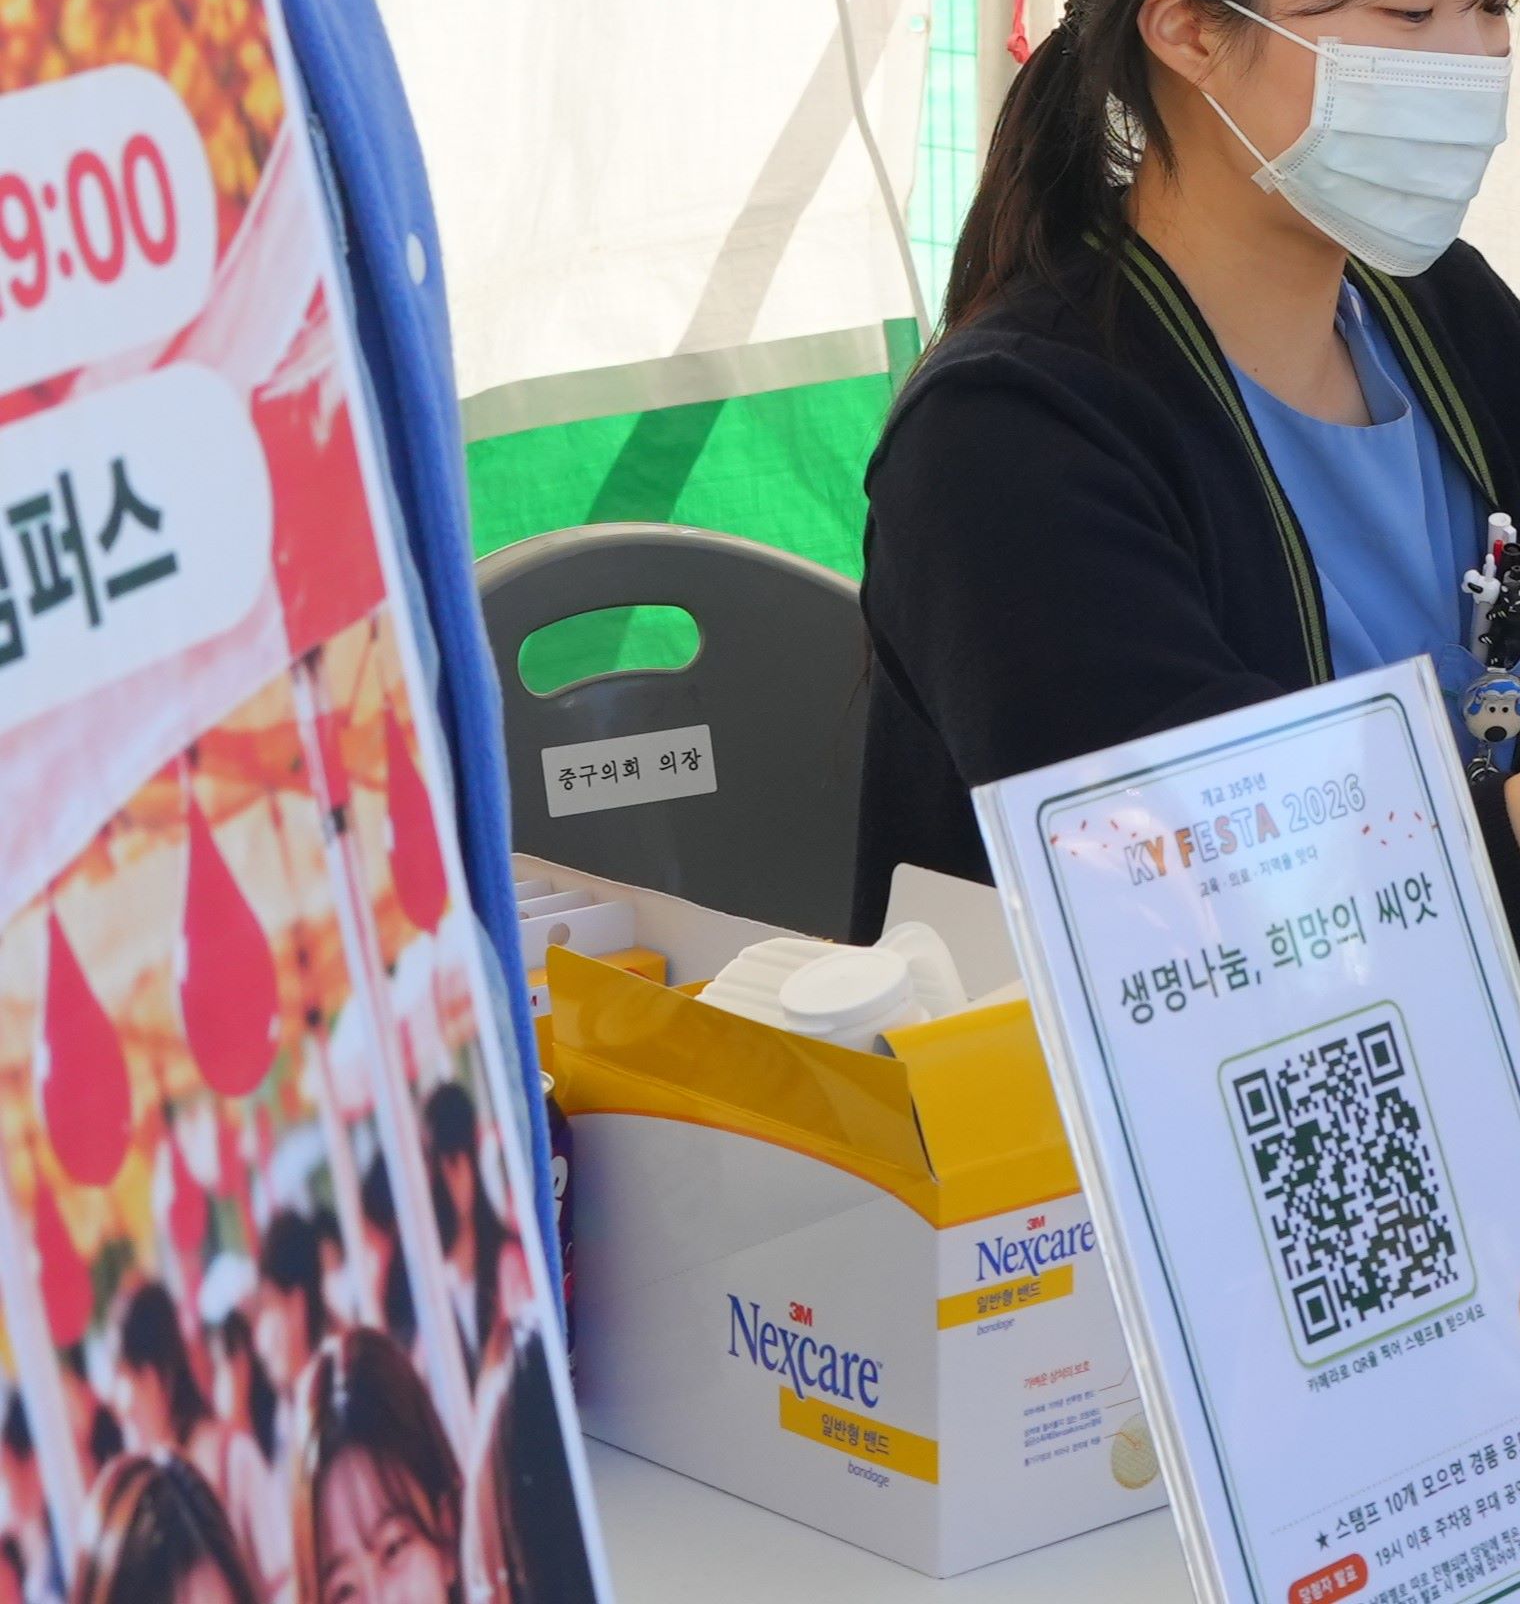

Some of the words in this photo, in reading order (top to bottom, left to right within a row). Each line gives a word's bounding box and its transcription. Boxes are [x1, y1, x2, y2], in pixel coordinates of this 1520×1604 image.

[0, 132, 178, 320] 9:00
[558, 756, 641, 791] 중구의회
[658, 747, 702, 775] 의장
[1230, 772, 1266, 799] 35주년
[1124, 836, 1166, 886] KY
[1175, 802, 1281, 869] FESTA
[1282, 773, 1366, 833] 2026
[1120, 943, 1262, 1025] 생명나눔,
[1266, 896, 1367, 968] 희망의
[1376, 872, 1438, 930] 씨앗
[976, 1220, 1096, 1281] Nexcare
[1027, 1215, 1045, 1231] 3M
[789, 1301, 813, 1327] 3M
[977, 1288, 1013, 1314] 일반형
[727, 1293, 879, 1408] Nexcare
[1307, 1363, 1350, 1393] 카메라로
[1352, 1350, 1378, 1374] QR을
[1380, 1340, 1403, 1360] 찍어
[1405, 1321, 1443, 1351] 스탬프를
[1446, 1303, 1486, 1333] 받으세요
[821, 1414, 860, 1447] 일반형
[863, 1429, 890, 1456] 밴드
[1336, 1501, 1381, 1539] 스탬프
[1385, 1482, 1419, 1515] 10개
[1422, 1459, 1466, 1498] 모으면
[1469, 1444, 1498, 1476] 경품
[1375, 1539, 1404, 1567] 19시
[1406, 1526, 1432, 1550] 이후
[1435, 1505, 1472, 1538] 주차장
[1476, 1491, 1501, 1518] 무대
